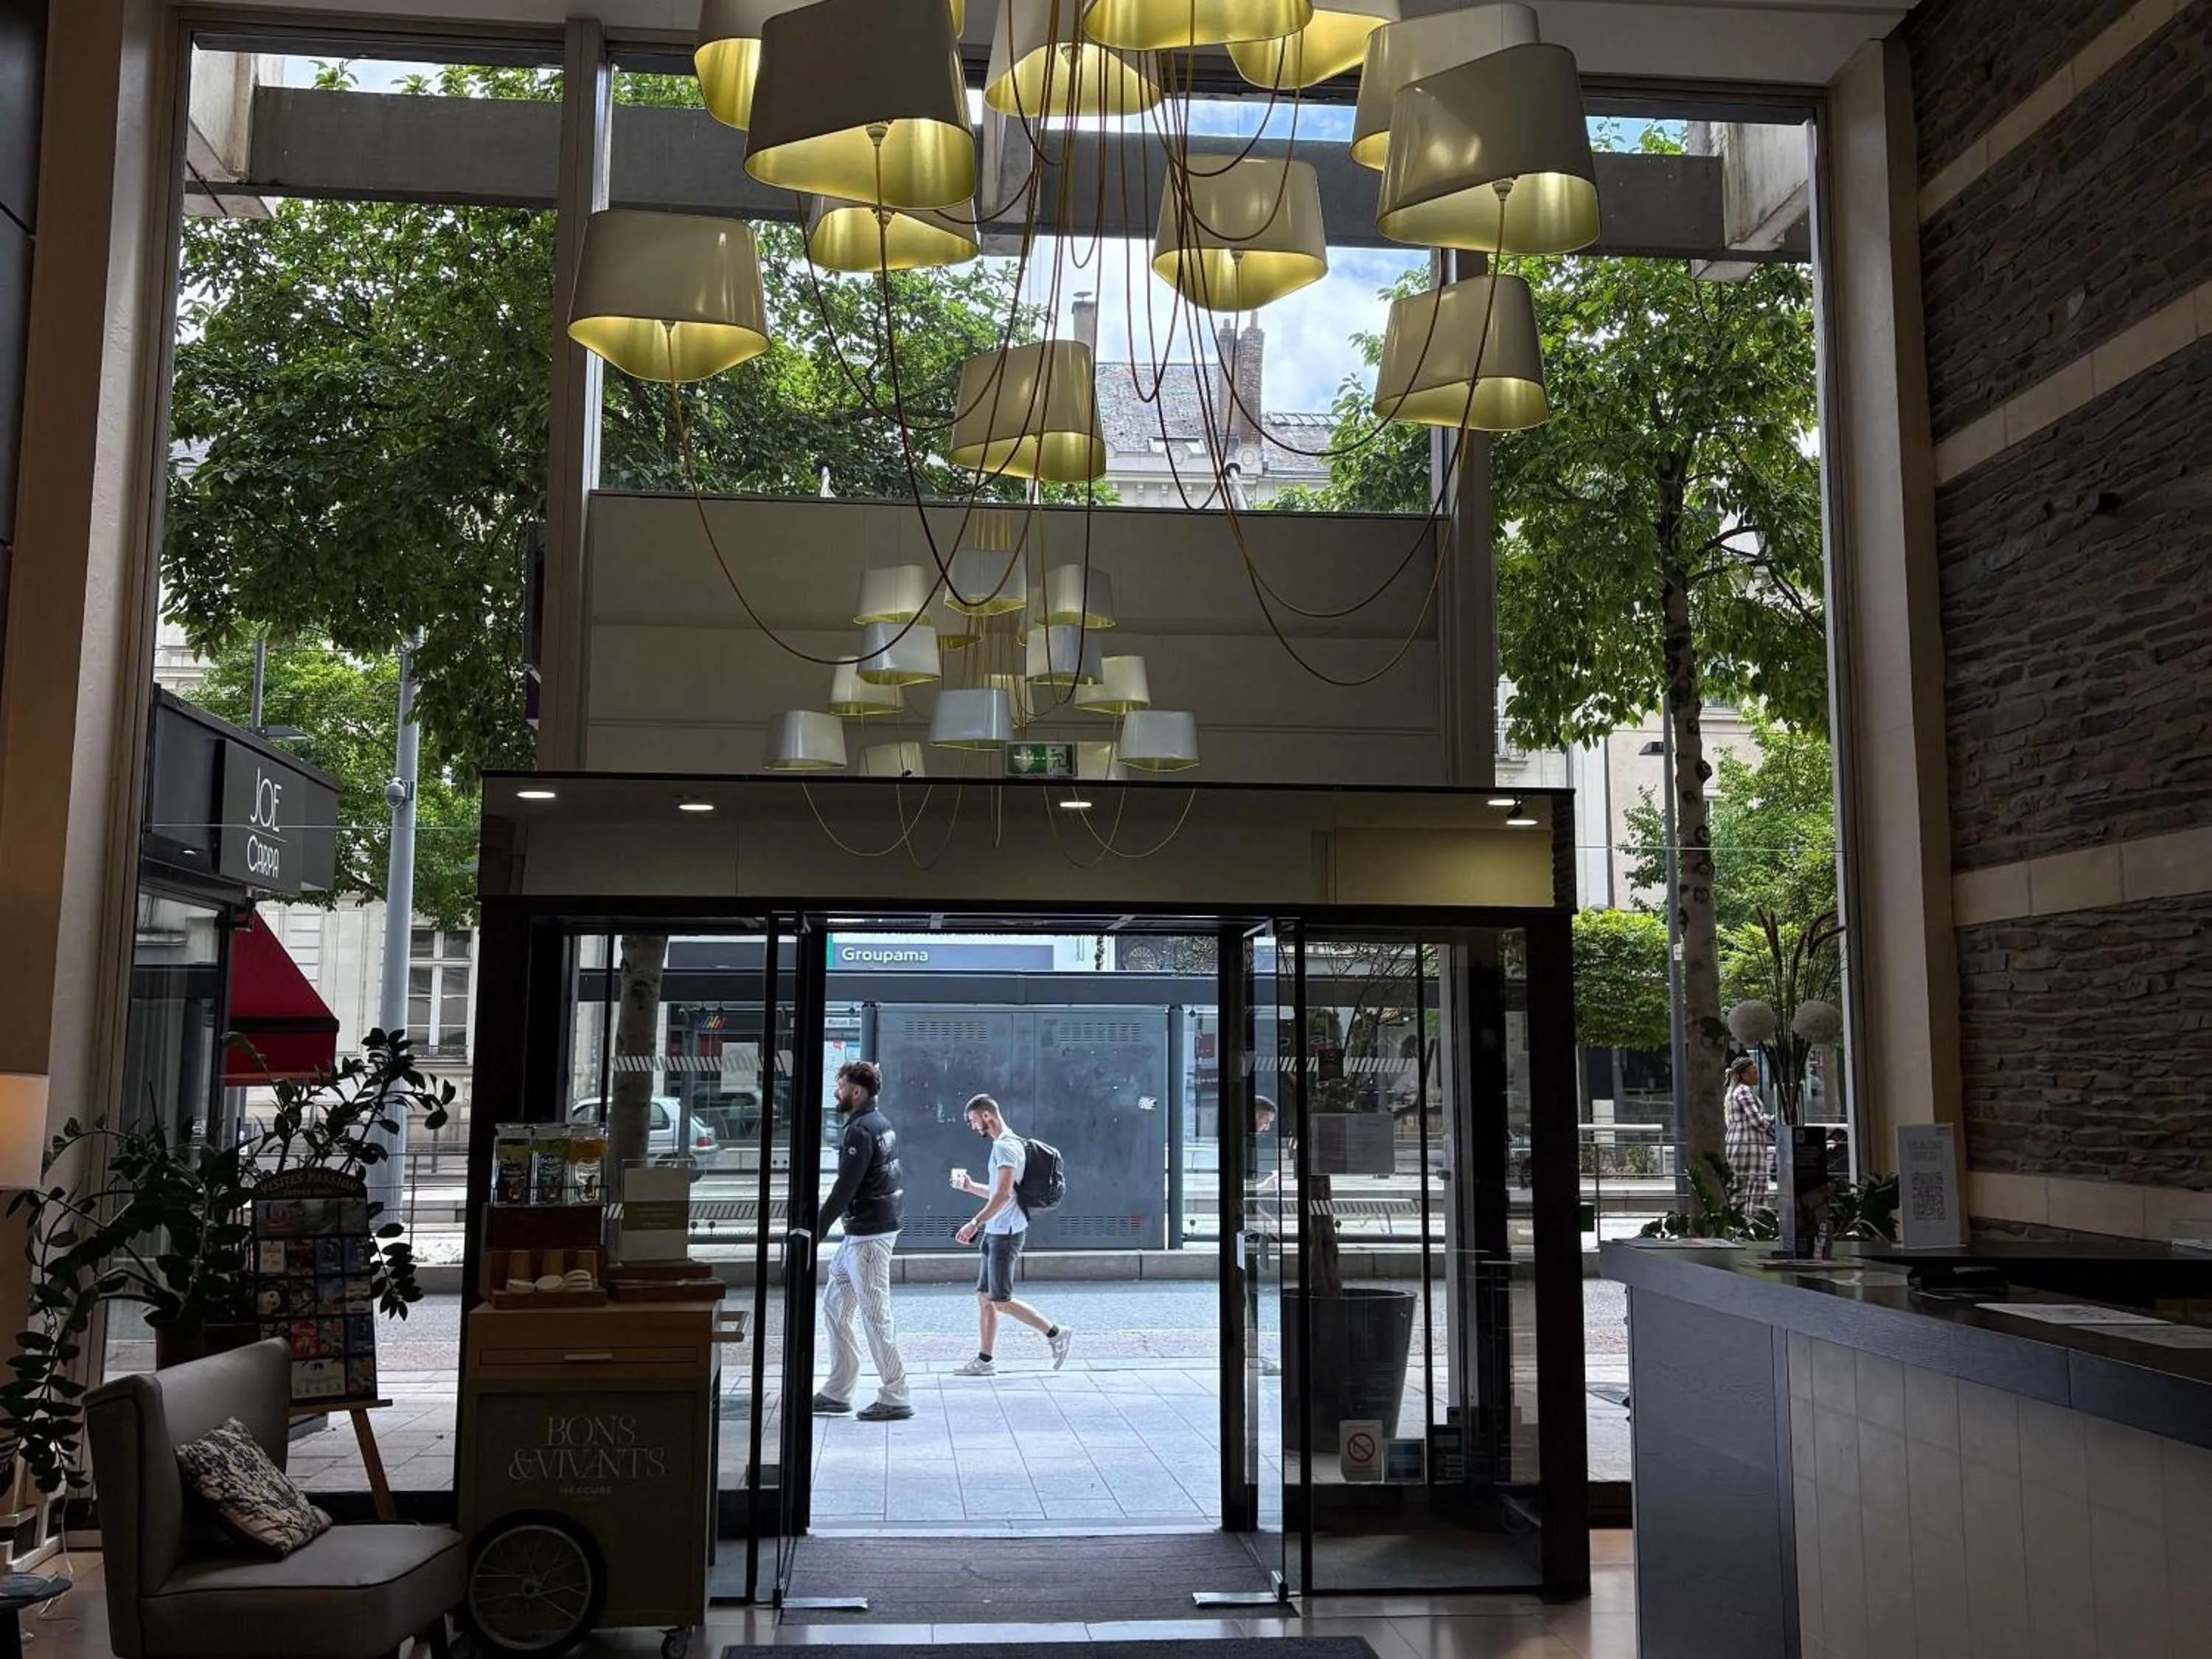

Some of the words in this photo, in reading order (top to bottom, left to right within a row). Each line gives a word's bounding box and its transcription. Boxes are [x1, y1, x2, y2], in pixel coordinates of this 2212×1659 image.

[250, 767, 282, 832] JOE
[841, 947, 928, 963] Groupama
[544, 1415, 636, 1445] BONS
